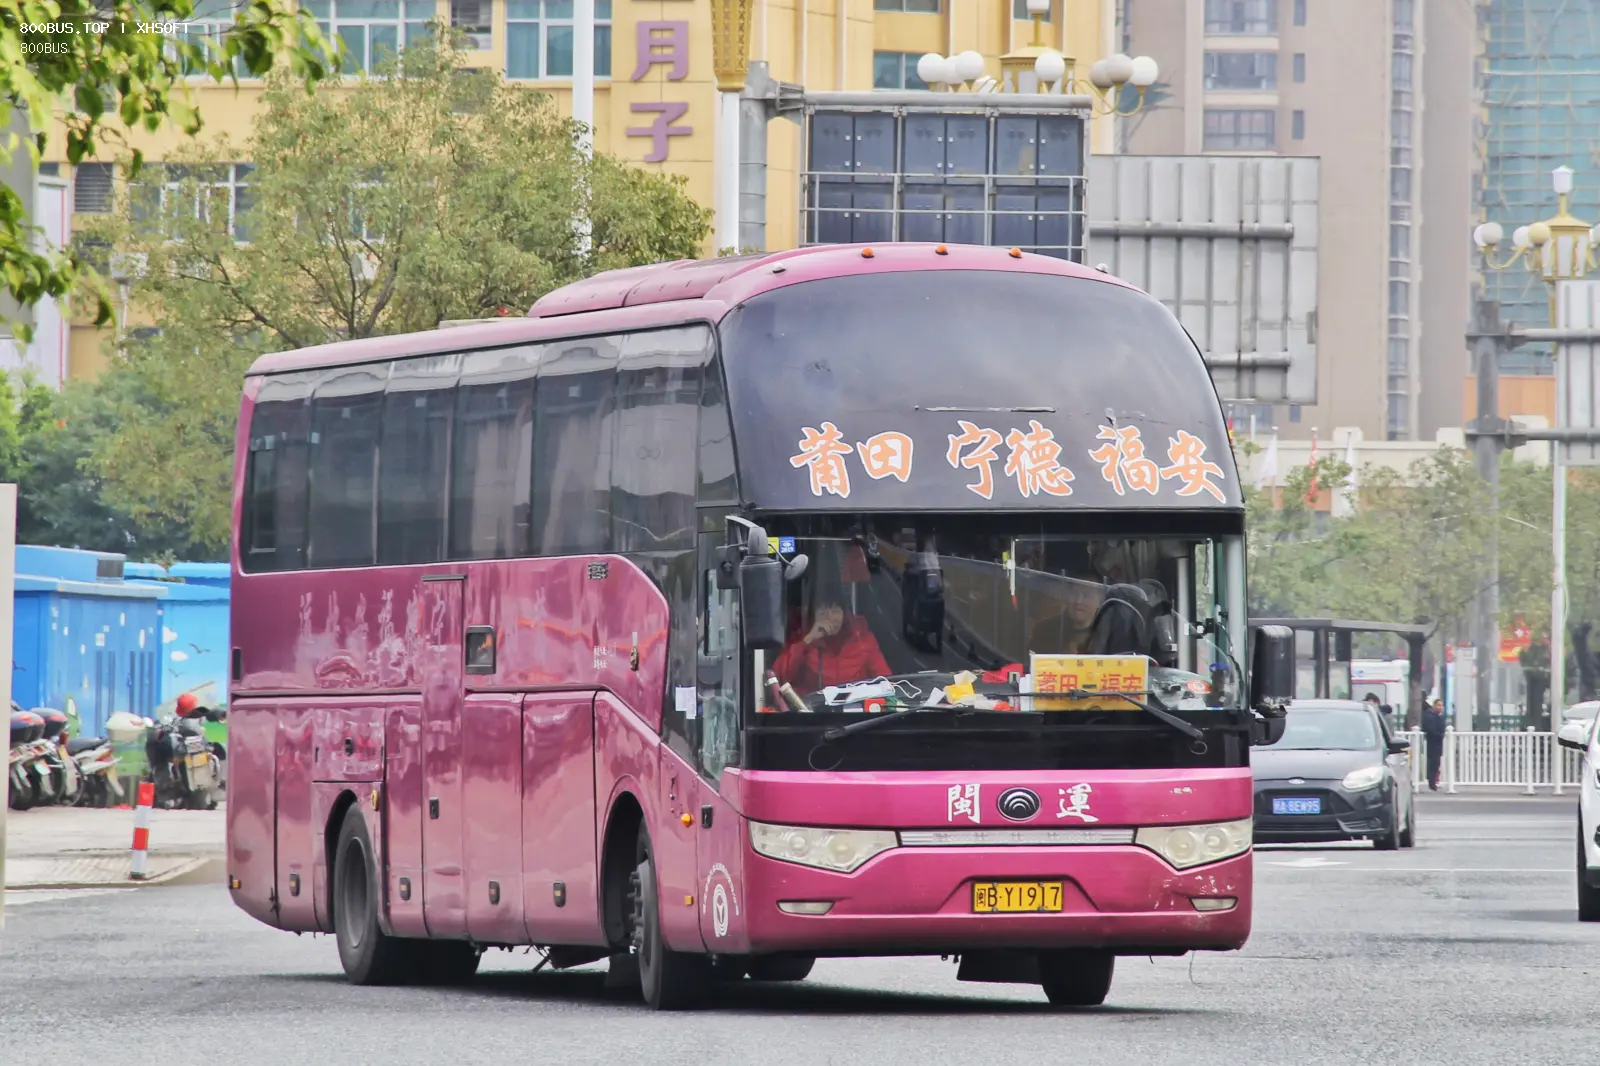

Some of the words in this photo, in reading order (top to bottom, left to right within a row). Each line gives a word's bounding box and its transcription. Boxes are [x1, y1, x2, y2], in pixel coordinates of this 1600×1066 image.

[625, 20, 693, 163] 月子
[790, 421, 914, 498] 莆田
[947, 420, 1076, 499] 宁德
[1089, 424, 1227, 503] 福安
[1056, 783, 1100, 823] 運
